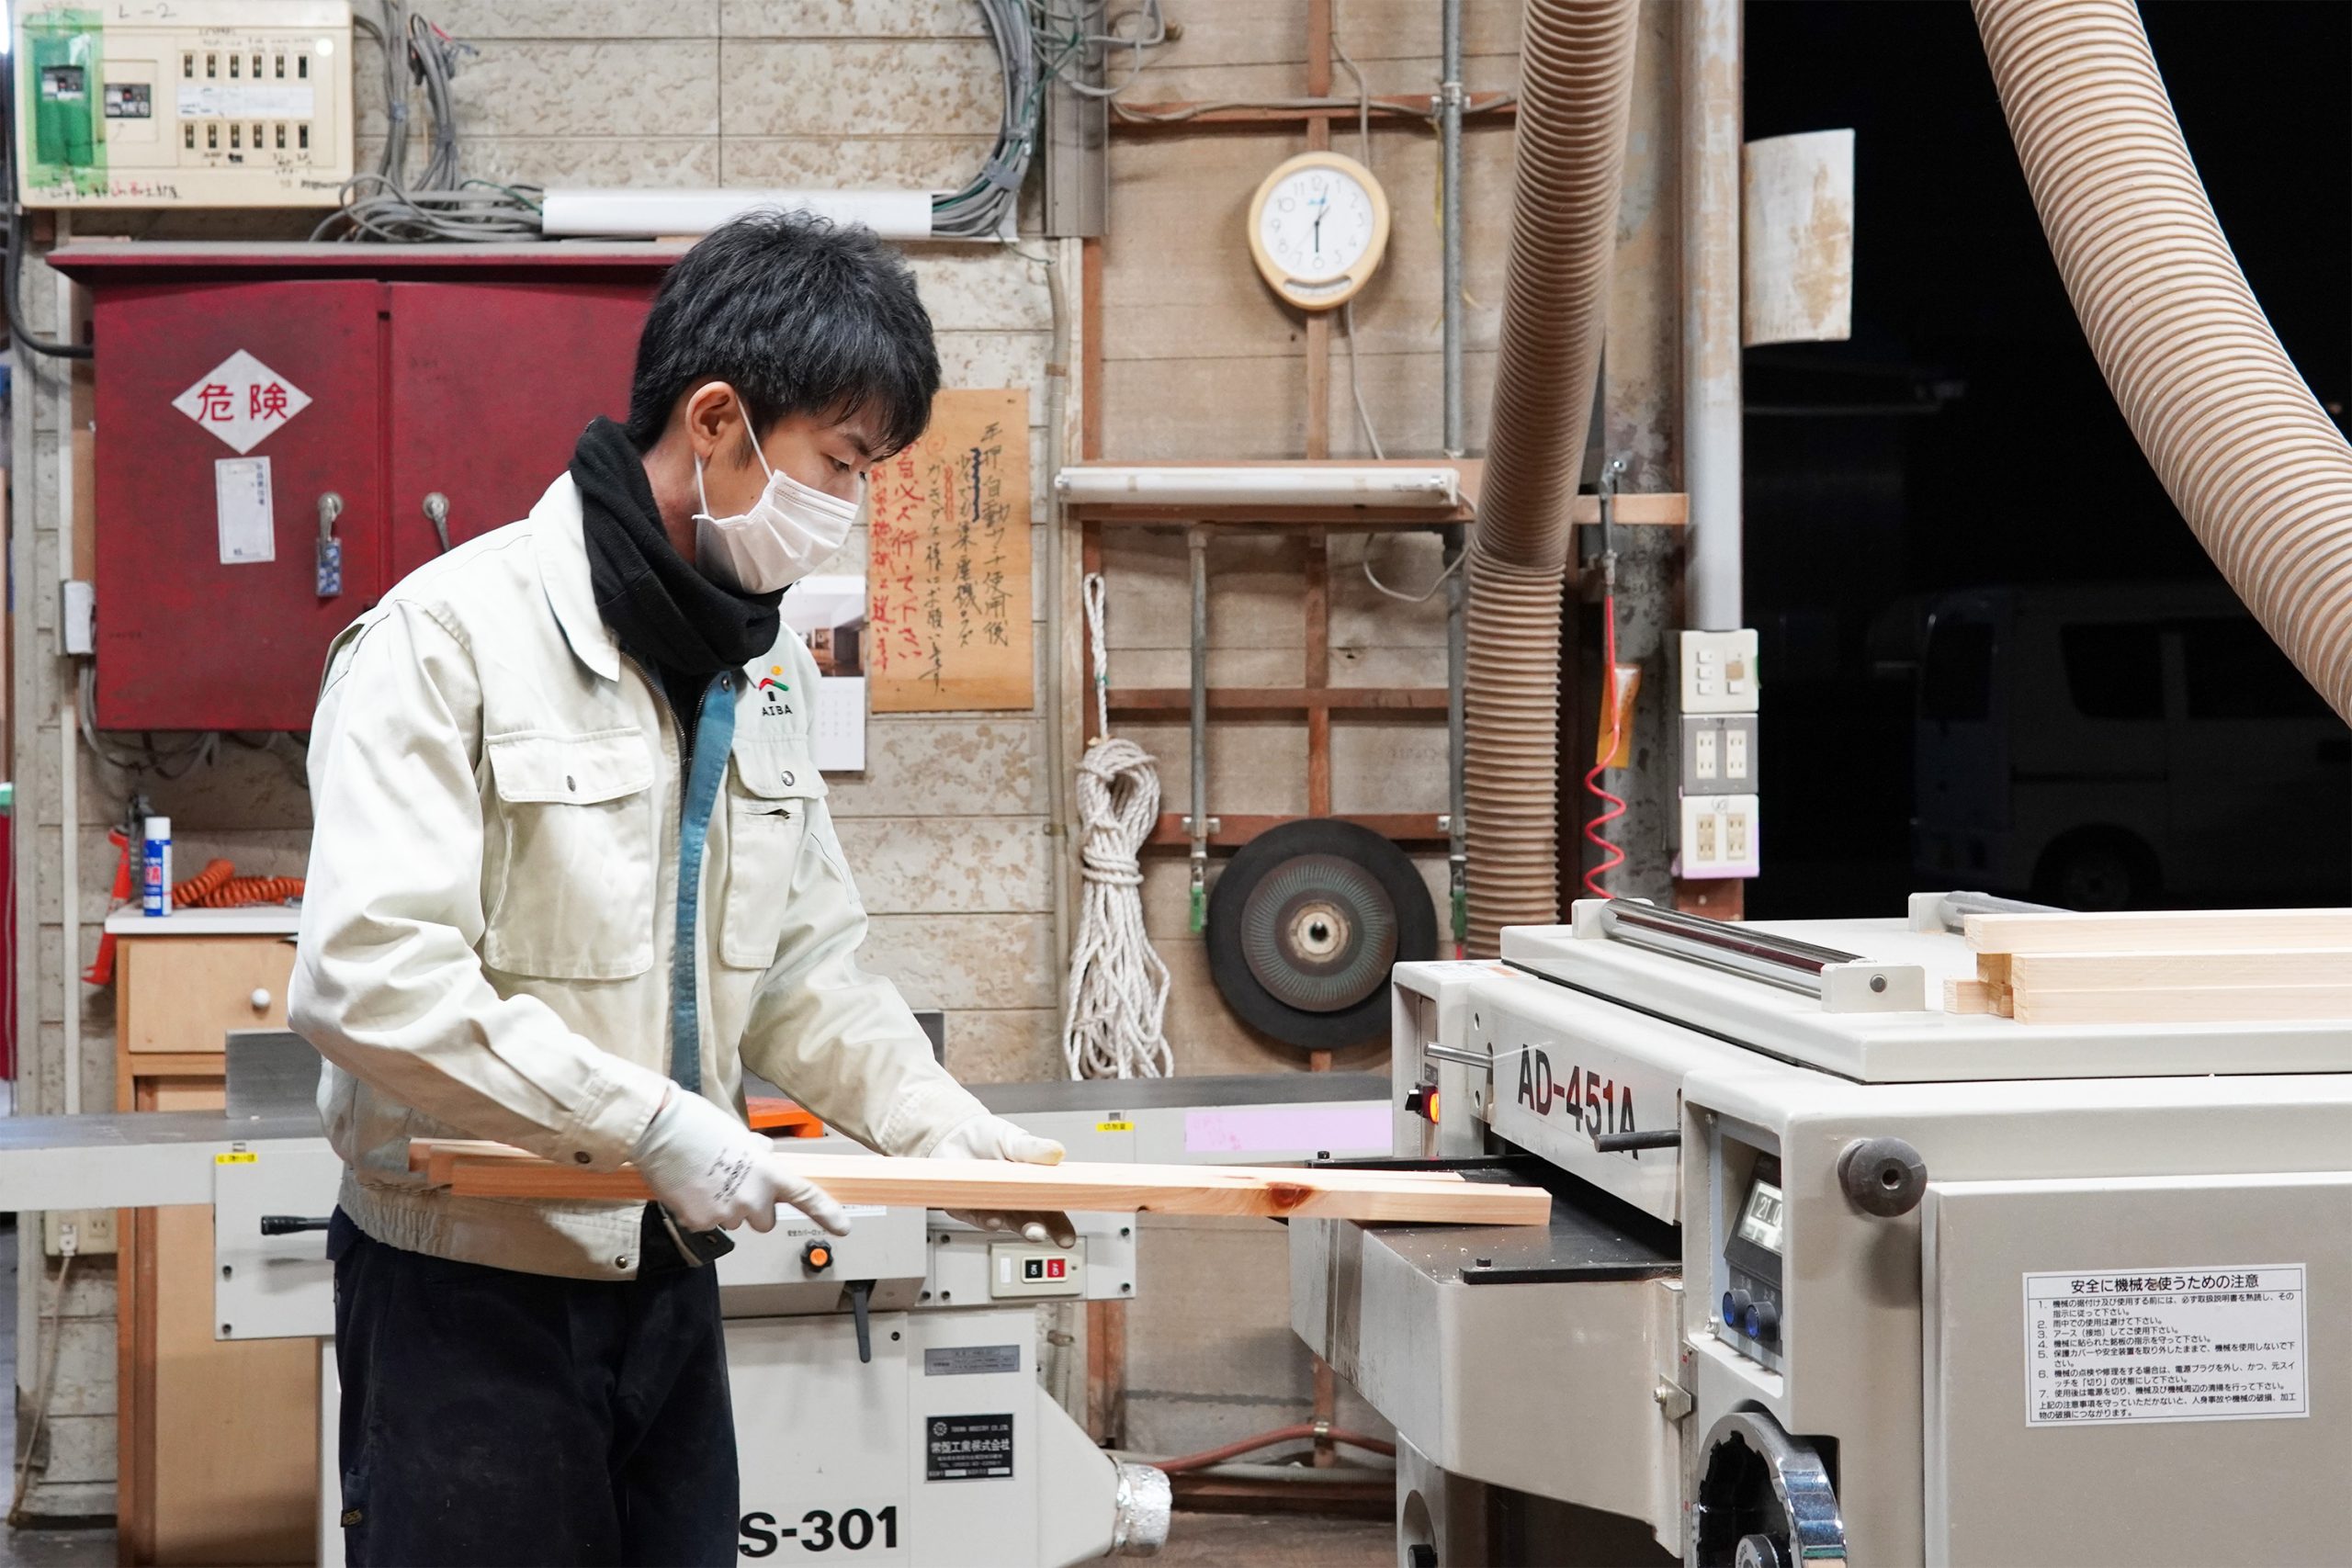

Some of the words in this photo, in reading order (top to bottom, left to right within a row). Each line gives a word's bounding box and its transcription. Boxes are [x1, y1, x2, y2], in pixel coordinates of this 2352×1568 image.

[198, 382, 288, 423] 危険
[762, 705, 793, 716] AIBA
[1518, 1043, 1638, 1160] AD-451A
[1031, 1264, 1037, 1275] ON
[2071, 1274, 2259, 1293] 安全に機械を使うための注意
[2054, 1359, 2075, 1368] さい。
[739, 1506, 897, 1558] S-301
